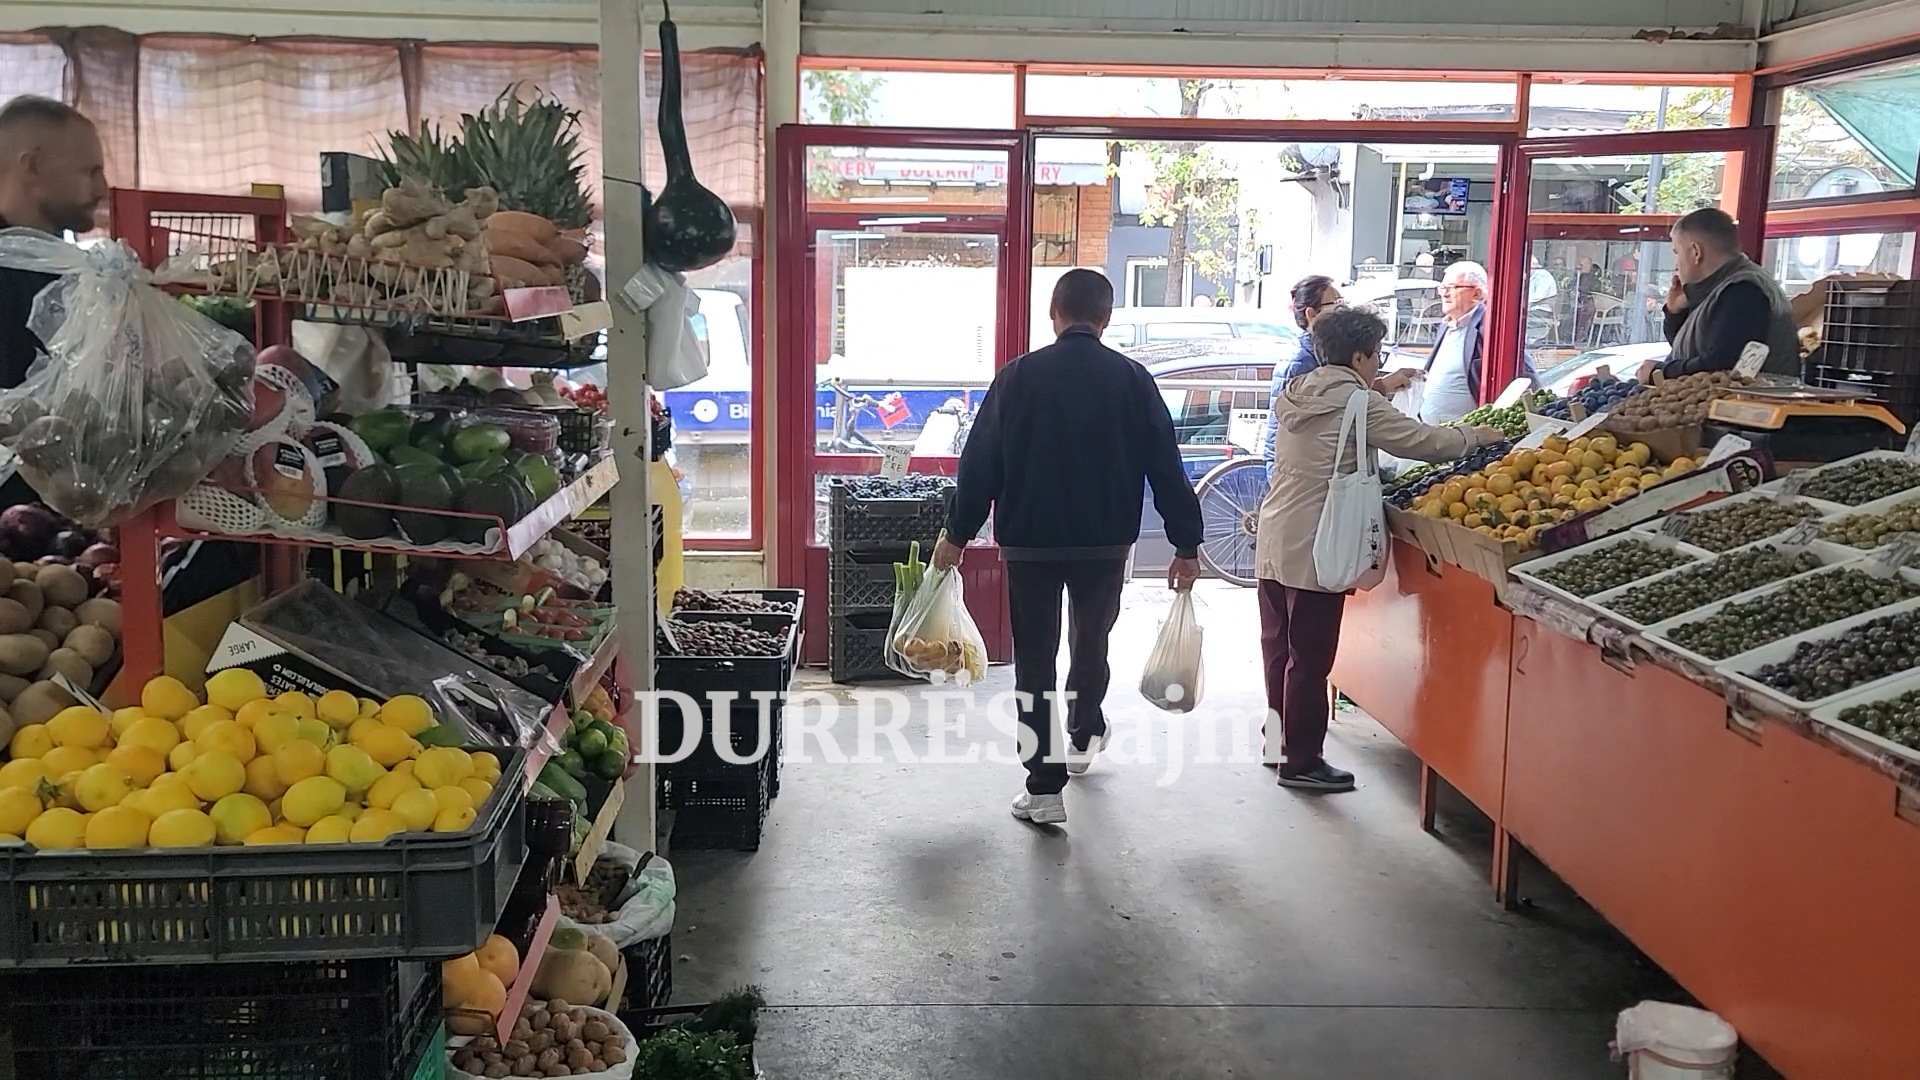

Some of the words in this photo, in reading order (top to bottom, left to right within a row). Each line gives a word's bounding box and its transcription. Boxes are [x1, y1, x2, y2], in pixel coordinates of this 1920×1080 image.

[994, 165, 1061, 180] BRY
[729, 404, 749, 419] Bi
[227, 640, 257, 656] LARGE
[270, 674, 296, 692] DATES
